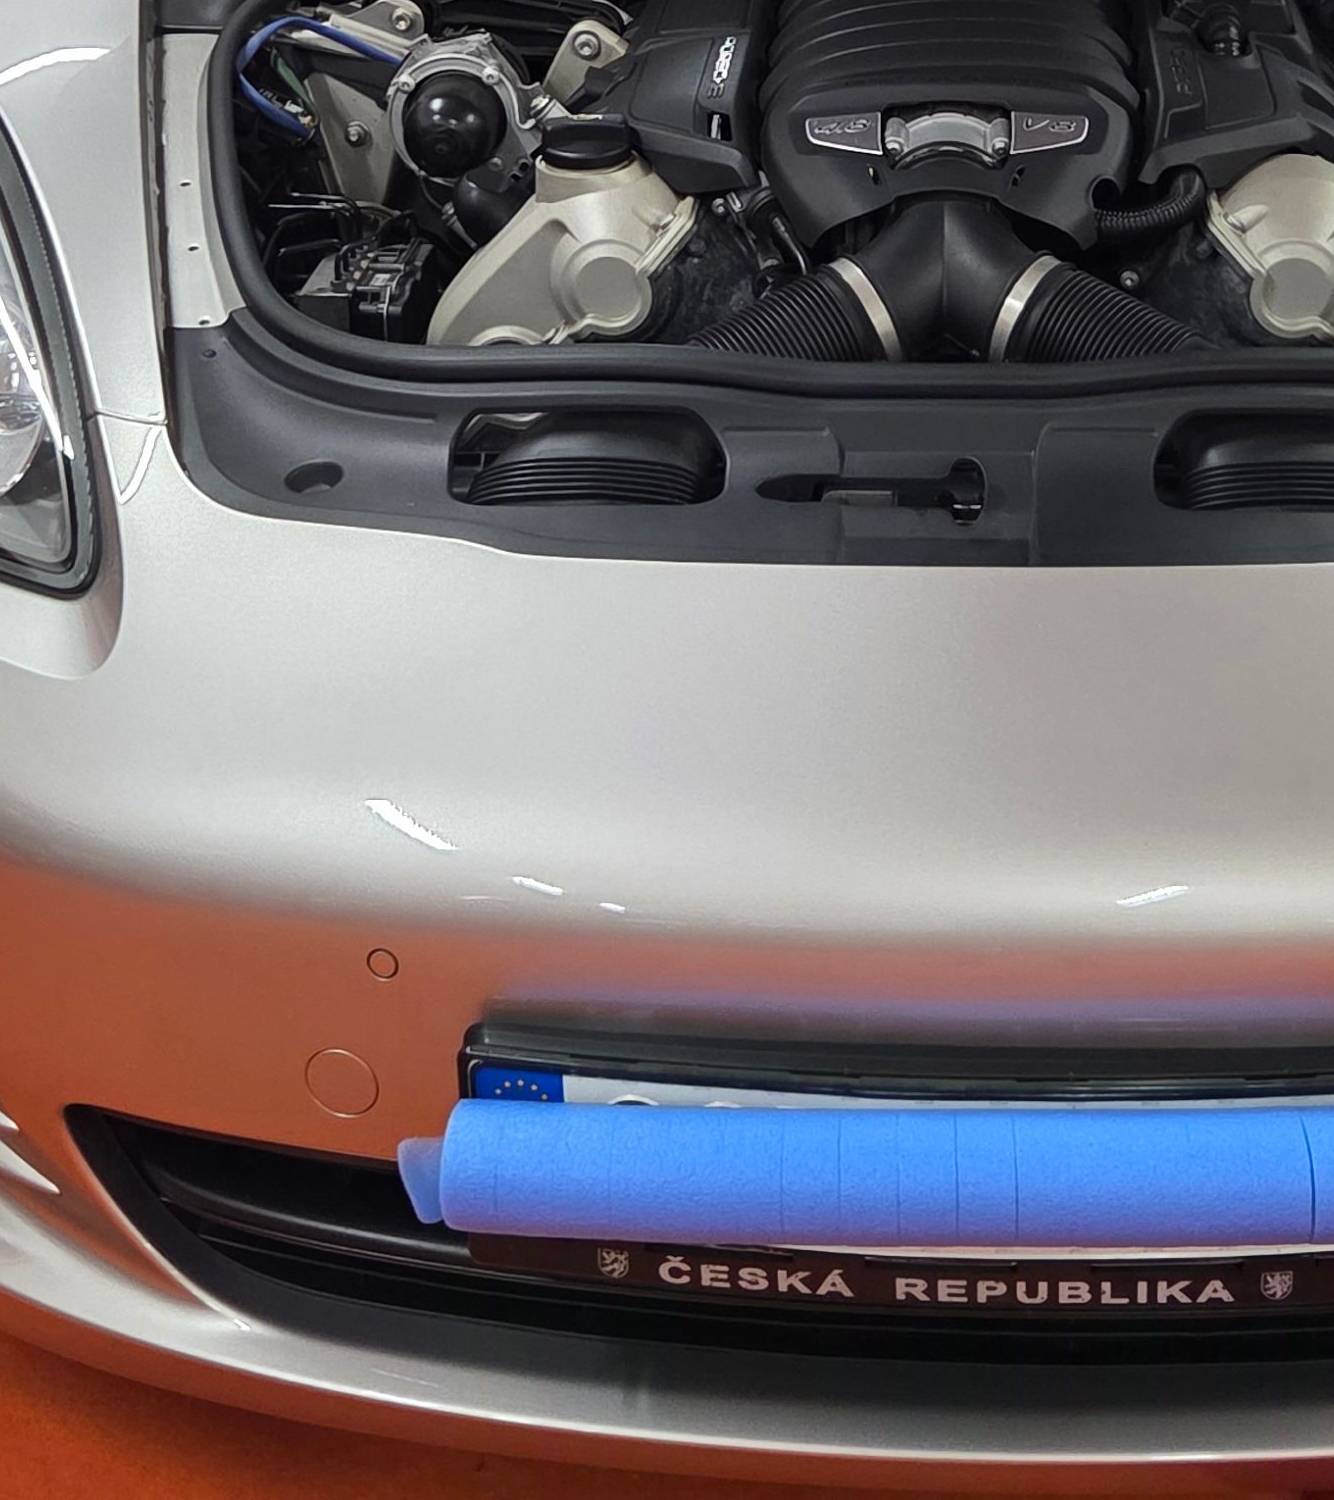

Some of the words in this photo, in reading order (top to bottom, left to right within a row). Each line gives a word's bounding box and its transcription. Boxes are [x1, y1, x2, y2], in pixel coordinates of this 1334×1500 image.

[1022, 117, 1077, 133] V8
[658, 1256, 855, 1298] ČESKÁ
[895, 1276, 1236, 1305] REPUBLIKA
